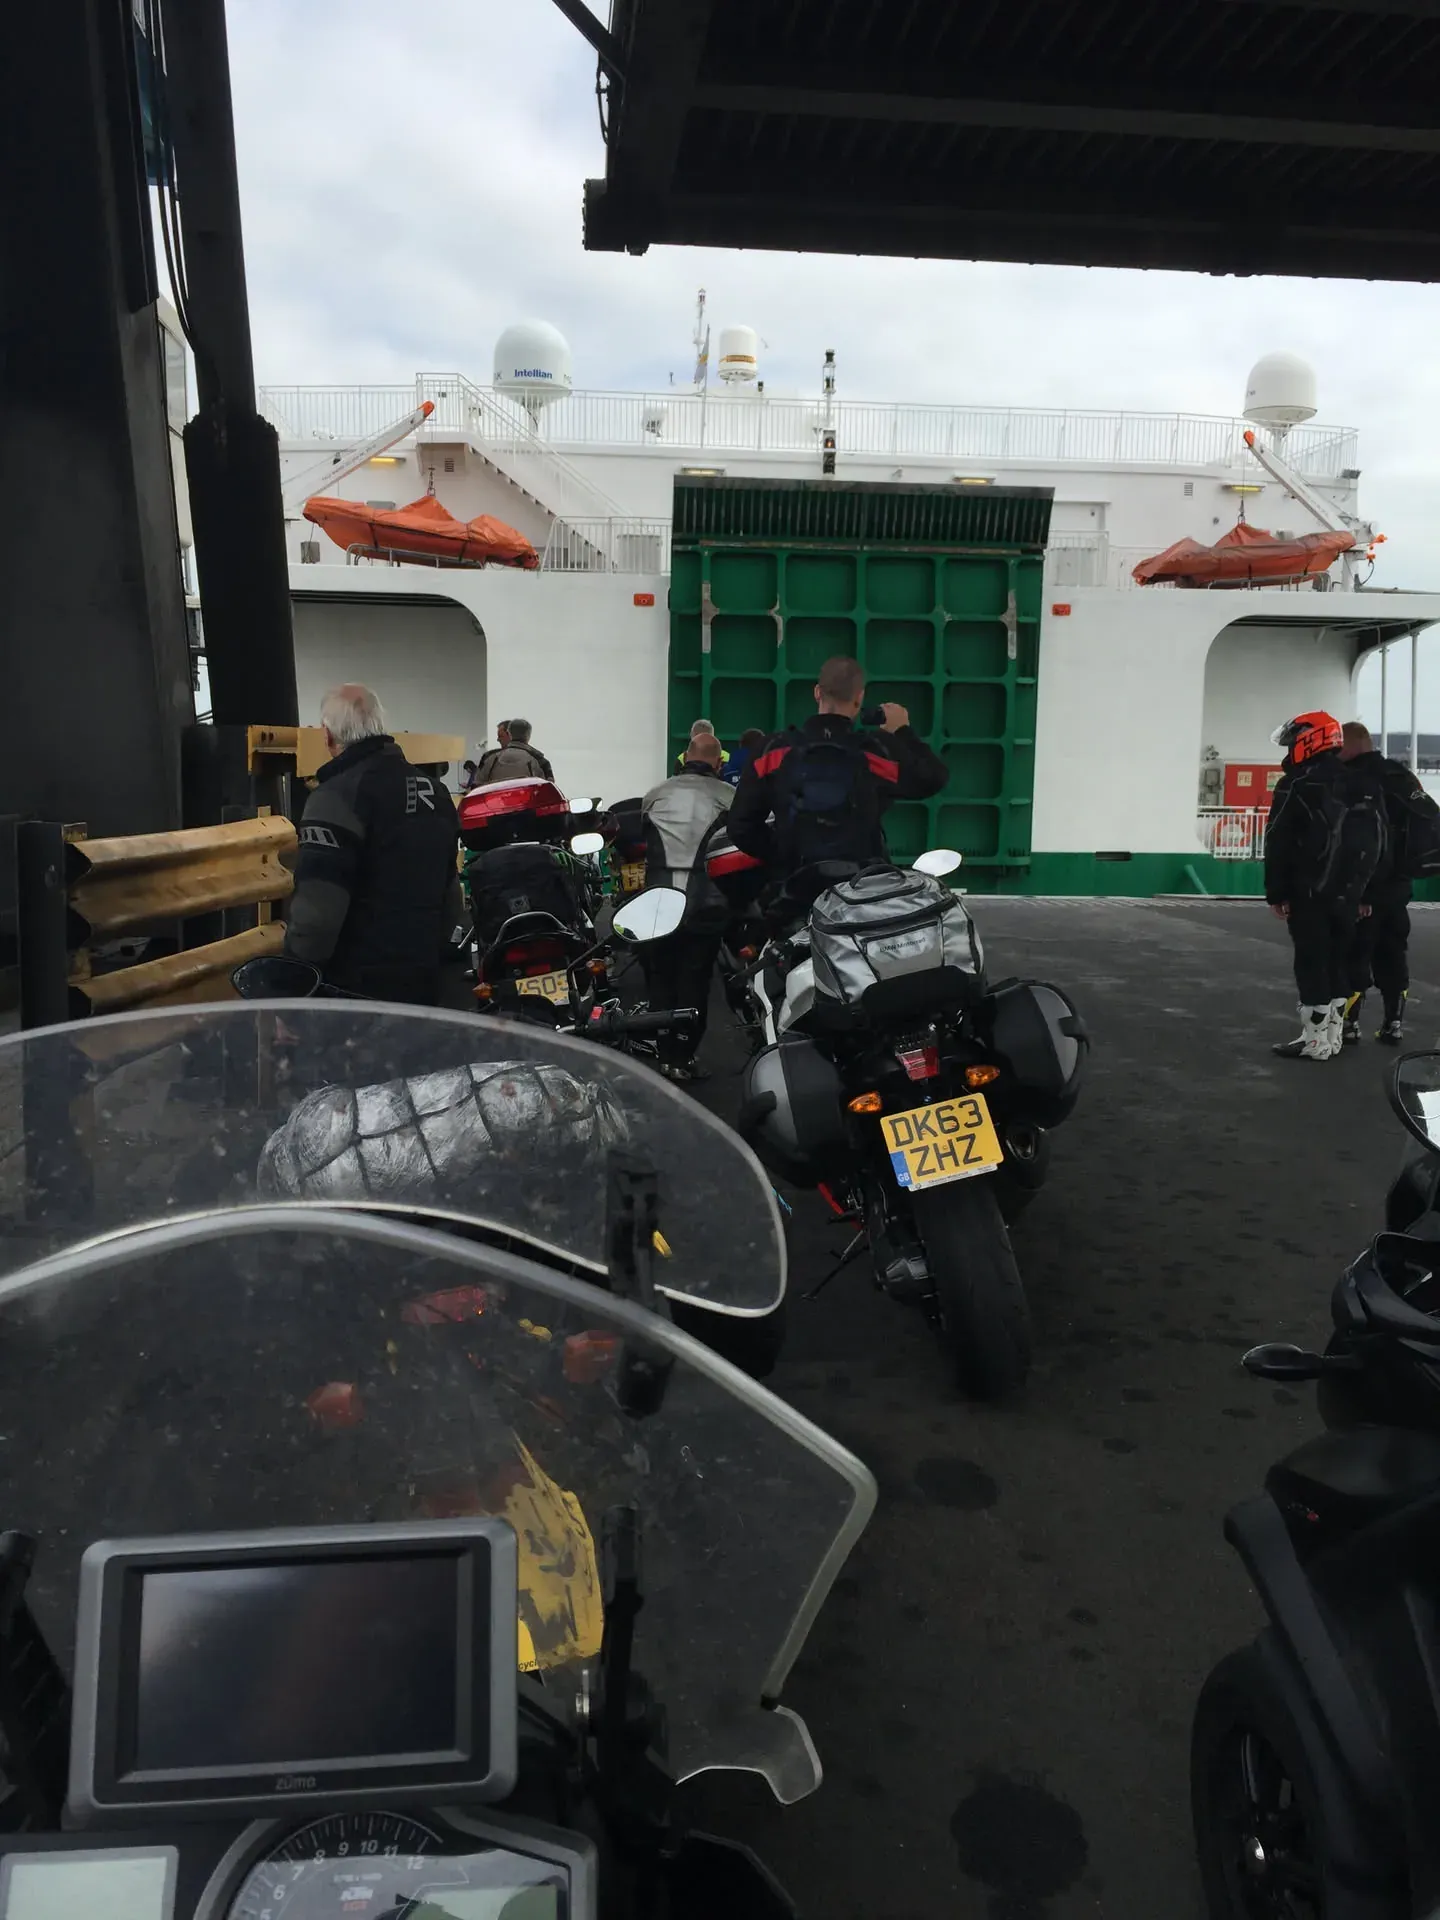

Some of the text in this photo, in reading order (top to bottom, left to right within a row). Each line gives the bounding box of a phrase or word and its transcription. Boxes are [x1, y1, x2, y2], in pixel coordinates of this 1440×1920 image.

[514, 368, 553, 379] Intellian
[888, 1098, 984, 1147] DK63
[909, 1133, 984, 1177] ZHZ
[897, 1172, 911, 1182] GB
[337, 1841, 350, 1856] 9
[360, 1839, 379, 1854] 10
[384, 1844, 399, 1858] 11
[313, 1849, 326, 1865] 8
[407, 1855, 424, 1870] 12
[293, 1865, 305, 1881] 7
[273, 1884, 286, 1900] 6
